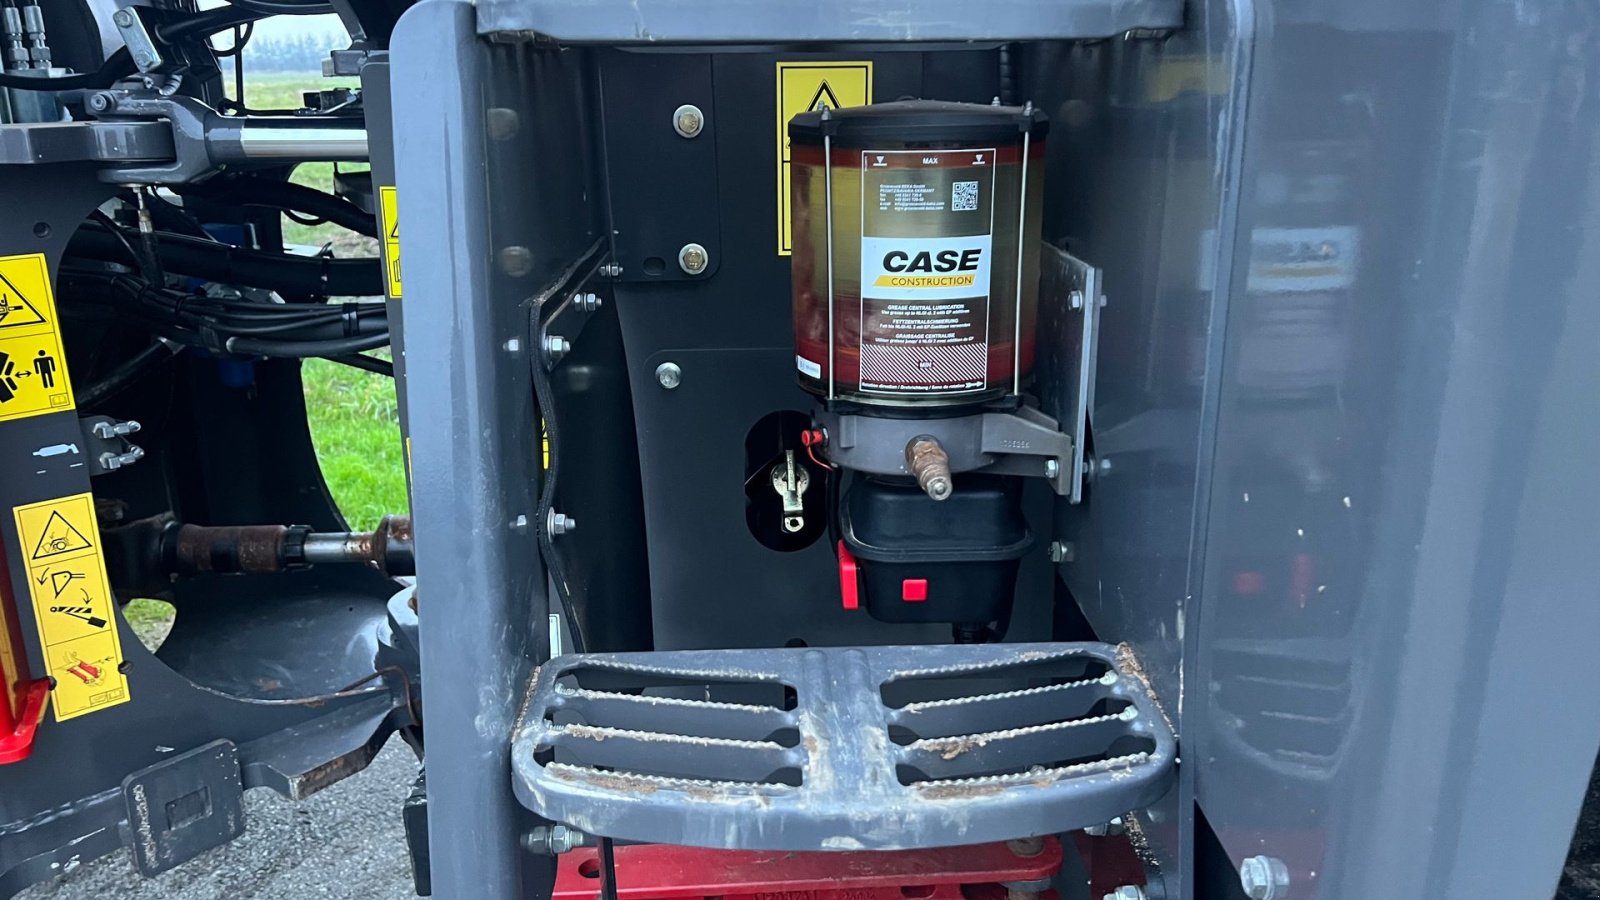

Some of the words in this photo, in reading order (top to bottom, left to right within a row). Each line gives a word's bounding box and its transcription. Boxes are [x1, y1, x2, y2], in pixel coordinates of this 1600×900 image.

[883, 248, 982, 273] CASE
[891, 276, 972, 287] CONSTRUCTION
[919, 361, 933, 369] MIN
